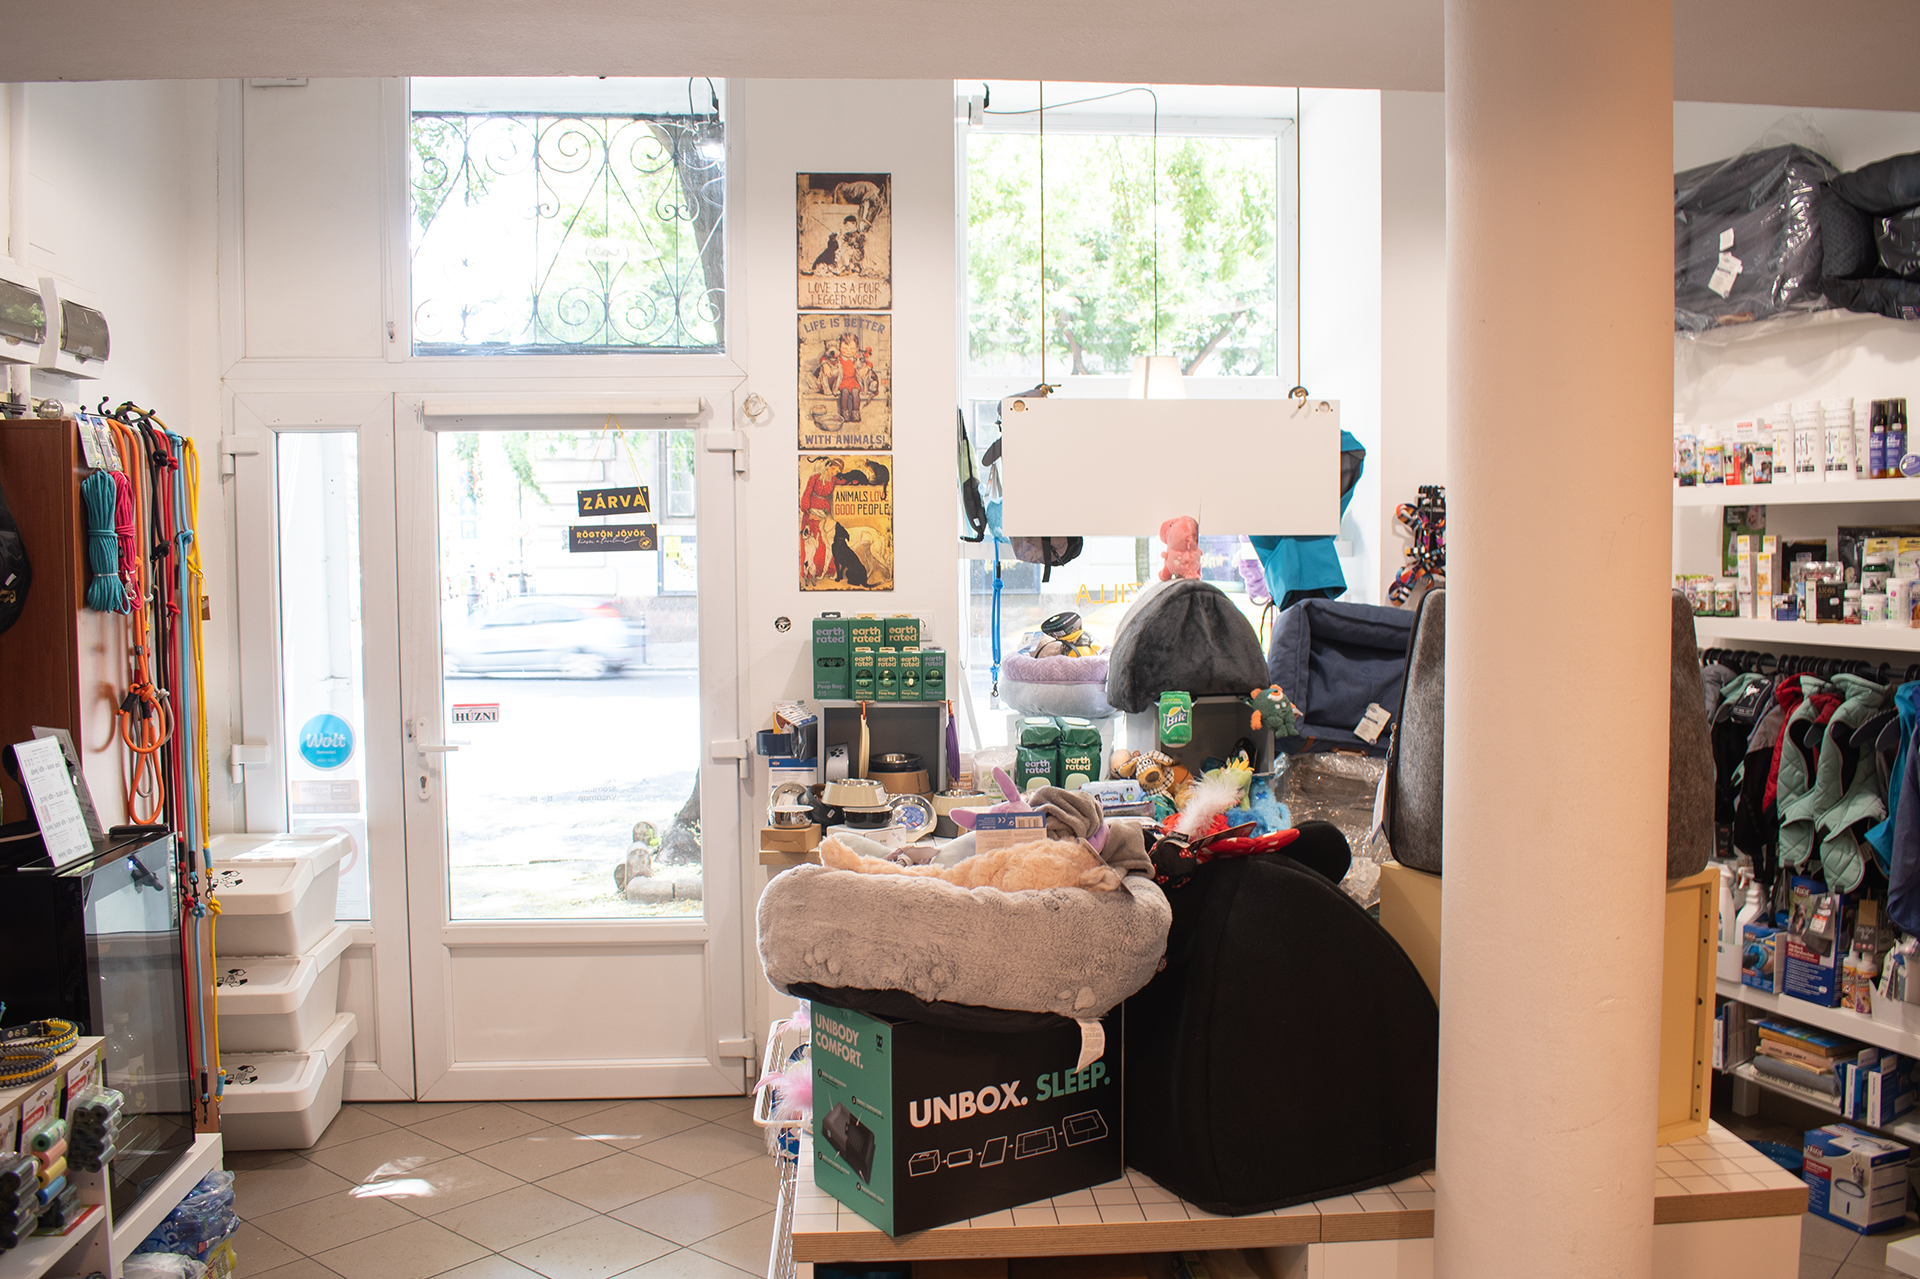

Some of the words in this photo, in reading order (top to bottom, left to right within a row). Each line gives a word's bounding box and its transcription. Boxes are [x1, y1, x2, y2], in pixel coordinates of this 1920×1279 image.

[808, 282, 830, 294] LOVE
[834, 282, 847, 293] IS
[850, 282, 856, 293] A
[858, 282, 881, 293] FOUR
[811, 293, 846, 305] LEGGED
[848, 293, 878, 305] WORD!
[803, 318, 826, 333] LIFE
[830, 318, 840, 328] IS
[844, 317, 886, 334] BETTER
[805, 434, 831, 445] WITH
[835, 434, 885, 445] ANIMALS!
[582, 492, 646, 510] ZÁRVA
[835, 491, 868, 502] ANIMALS
[869, 490, 889, 502] LOVE
[835, 503, 855, 515] GOOD
[857, 503, 889, 515] PEOPLE
[816, 627, 845, 635] earth
[852, 627, 881, 635] earth
[889, 625, 917, 633] earth
[816, 635, 845, 643] rated
[852, 634, 881, 643] rated
[889, 633, 917, 642] rated
[455, 709, 496, 721] HÚZNI
[306, 732, 346, 748] Wolt
[1025, 759, 1050, 767] earth
[1065, 756, 1091, 764] earth
[1025, 766, 1050, 774] rated
[1065, 763, 1091, 771] rated
[815, 1012, 859, 1047] UNIBODY
[815, 1031, 864, 1069] COMFORT.
[1036, 1061, 1111, 1101] SLEEP.
[909, 1080, 1028, 1128] UNBOX.
